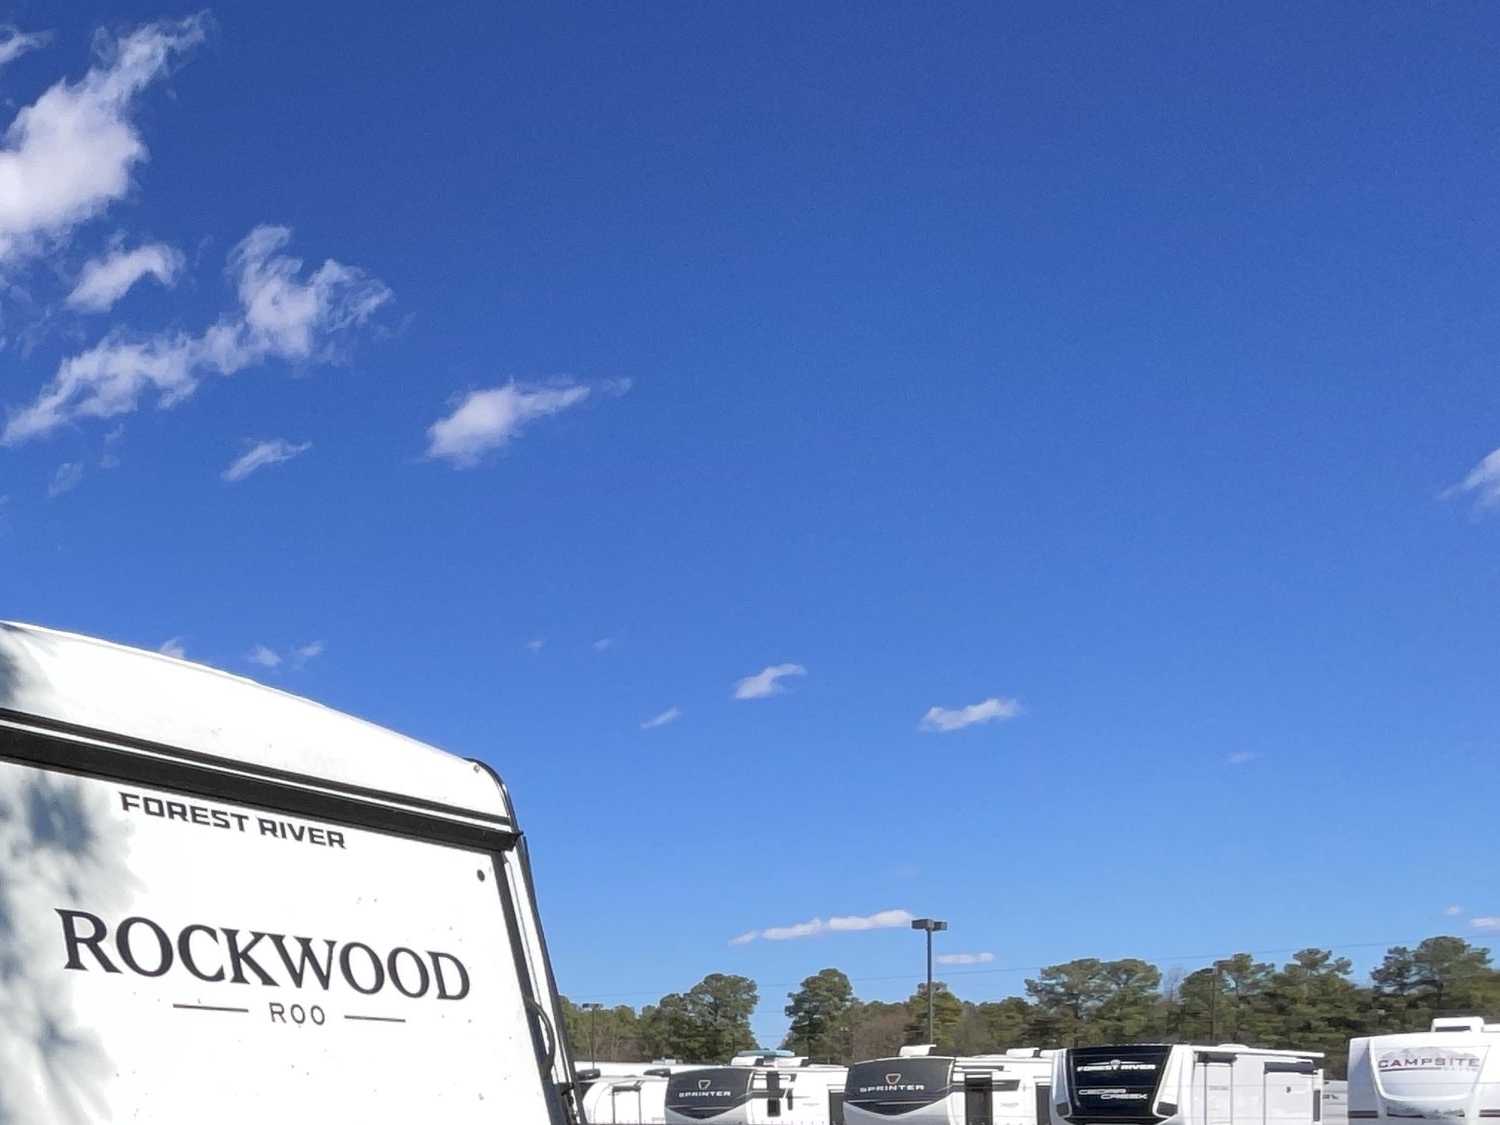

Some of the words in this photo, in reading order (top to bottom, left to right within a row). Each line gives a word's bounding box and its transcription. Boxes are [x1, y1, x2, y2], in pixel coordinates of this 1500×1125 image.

[118, 791, 249, 832] FOREST
[257, 817, 347, 849] RIVER
[54, 908, 471, 1000] ROCKWOOD
[268, 1002, 326, 1026] ROO
[1378, 1058, 1480, 1068] CAMPSITE
[860, 1085, 925, 1093] SPRINTER
